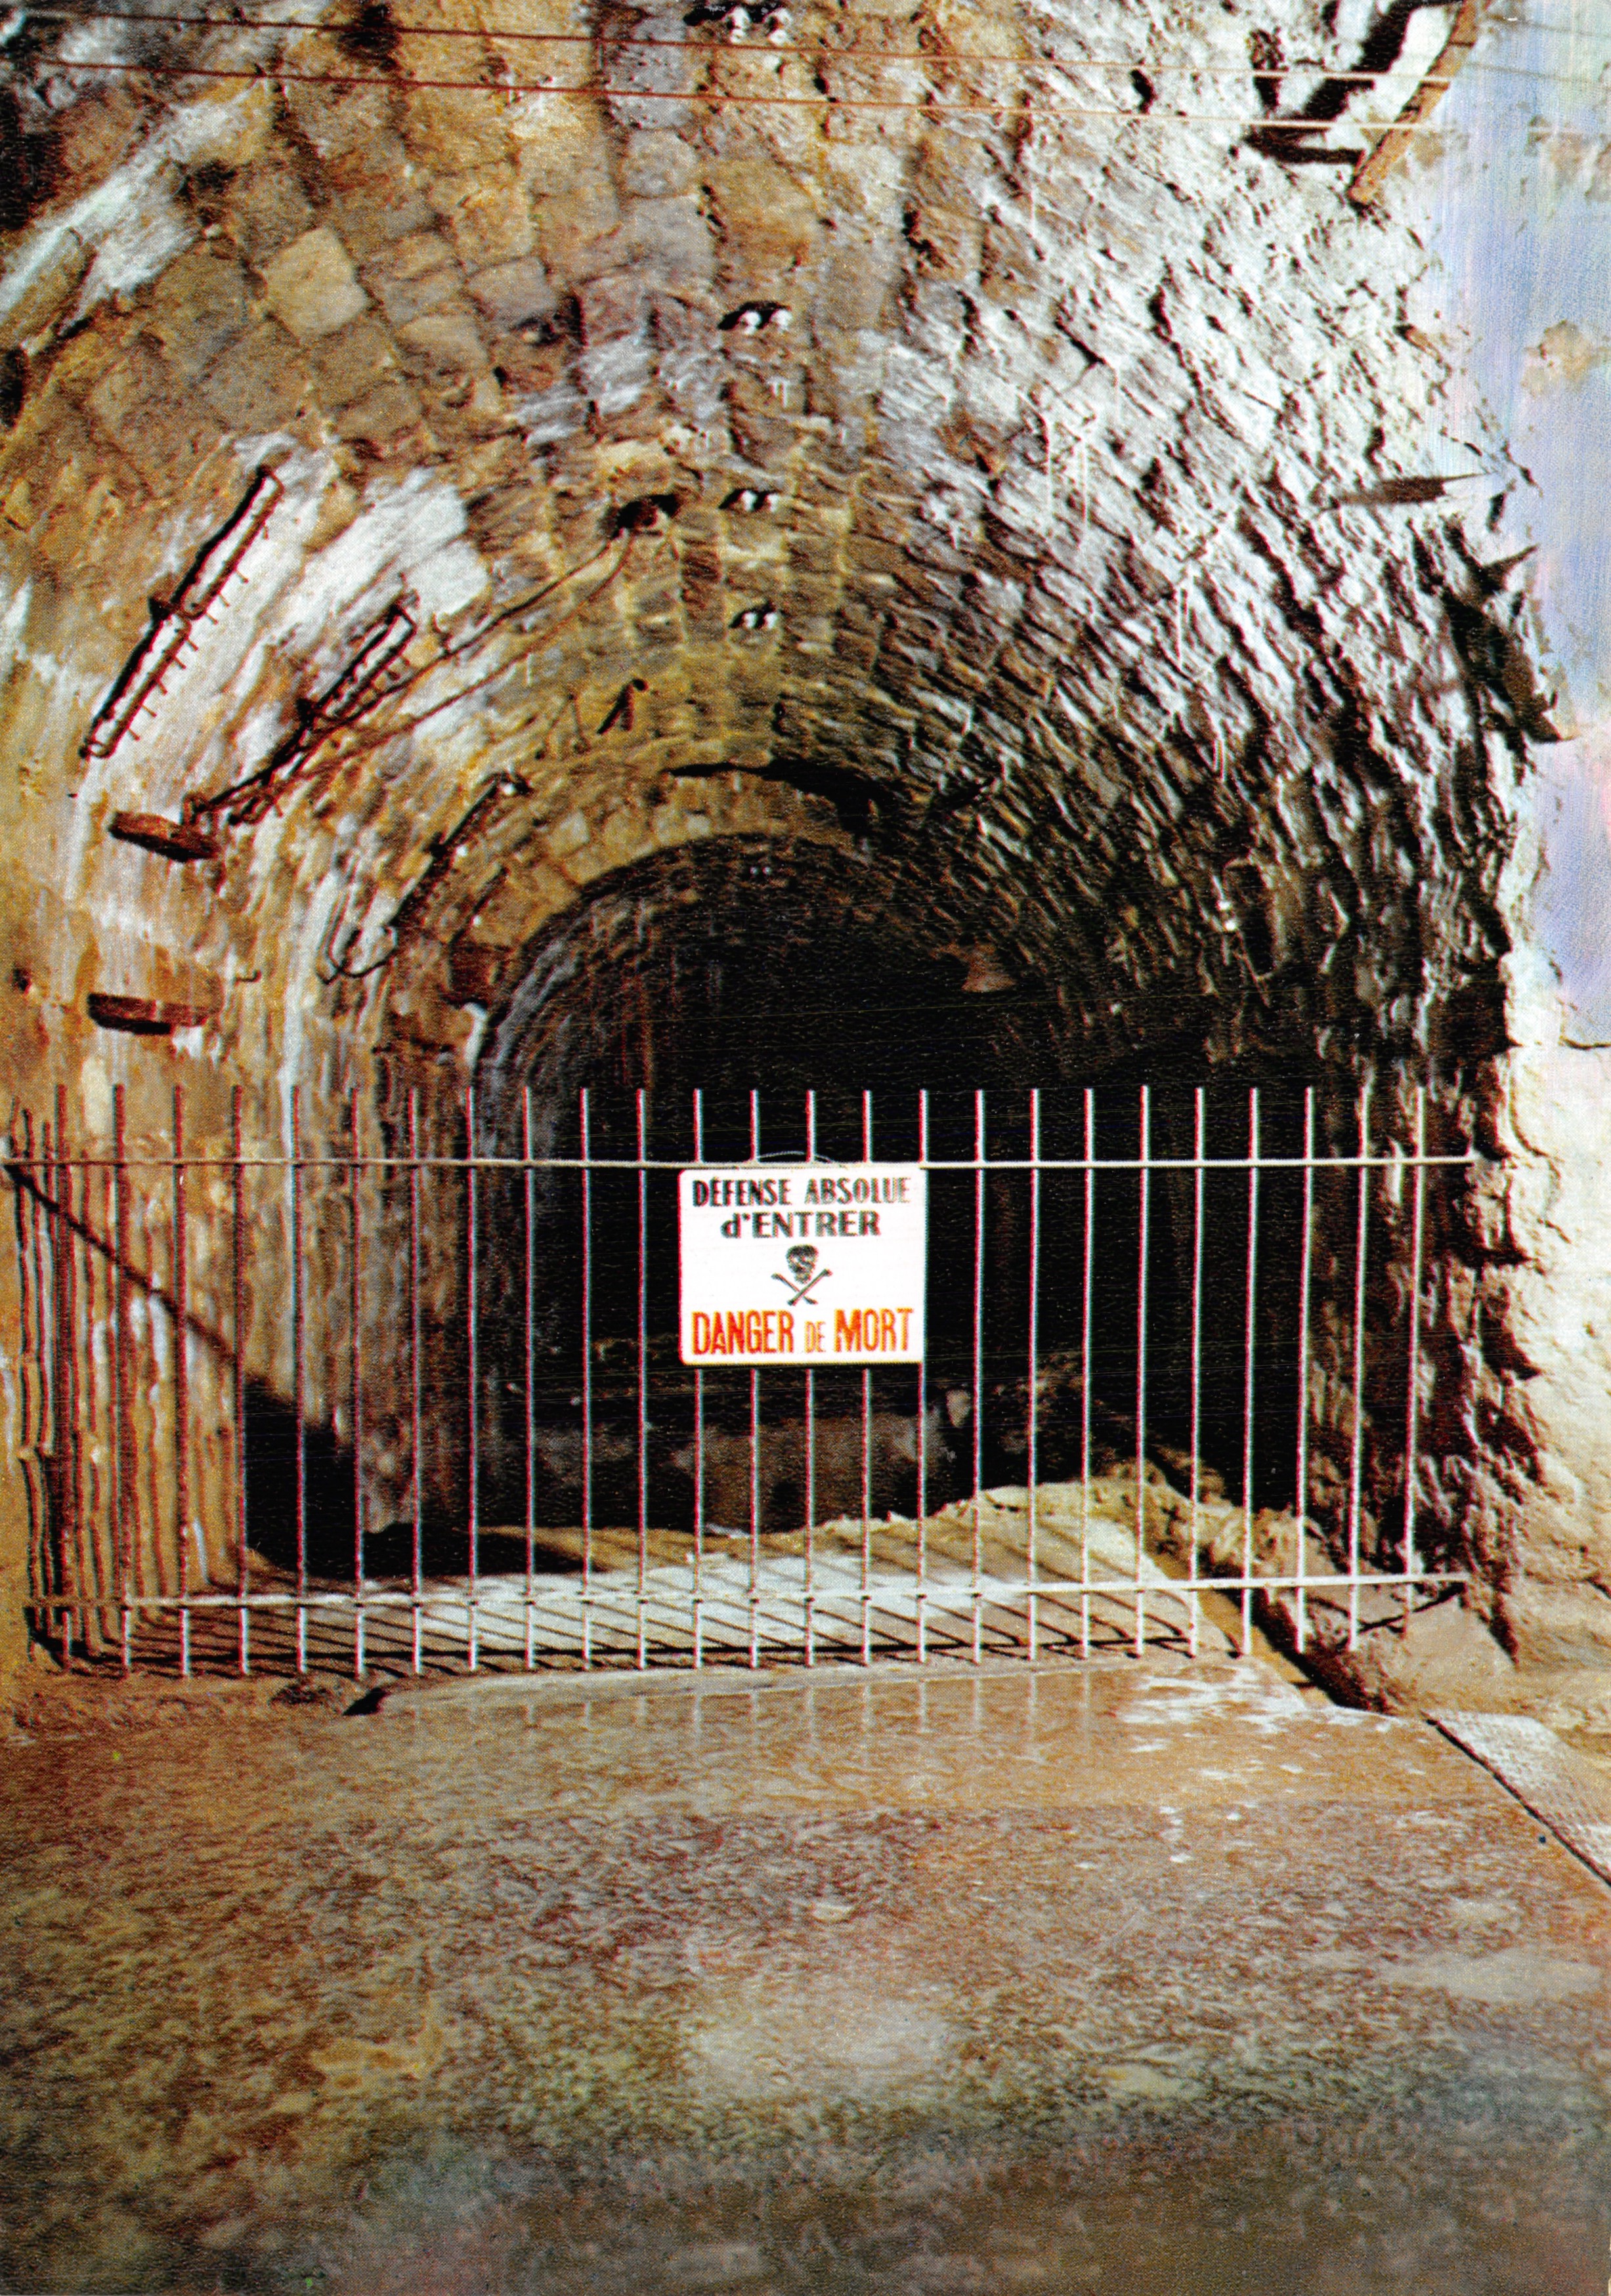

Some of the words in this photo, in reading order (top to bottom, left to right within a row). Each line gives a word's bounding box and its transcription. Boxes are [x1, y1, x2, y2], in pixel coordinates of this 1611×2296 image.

[692, 1177, 792, 1206] DÉFENSE
[804, 1177, 911, 1205] ABSOLUE
[720, 1210, 880, 1238] d'ENTRER
[691, 1309, 794, 1354] DANGER
[804, 1321, 825, 1352] DE
[834, 1307, 914, 1352] MORT
